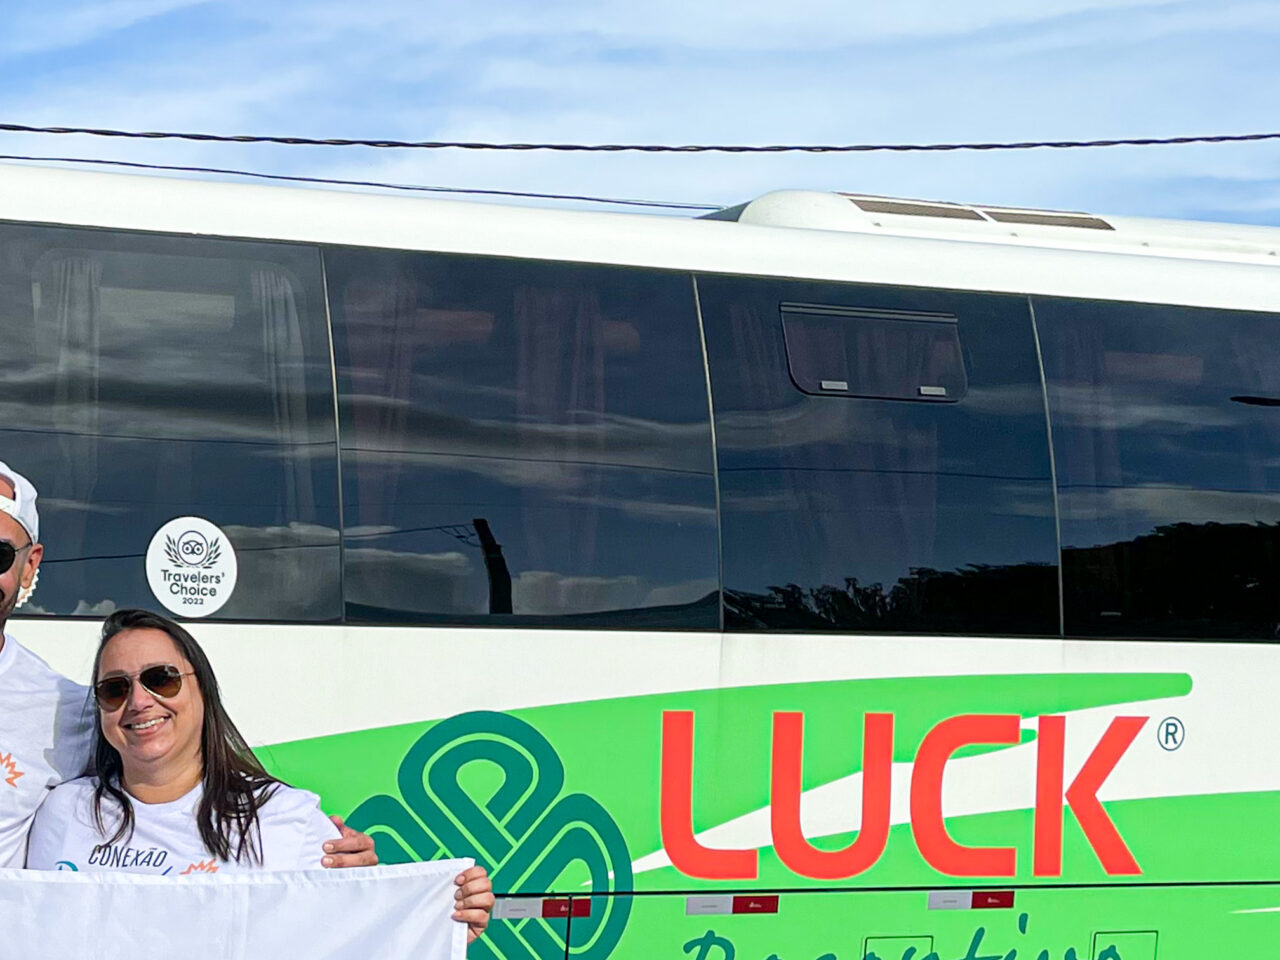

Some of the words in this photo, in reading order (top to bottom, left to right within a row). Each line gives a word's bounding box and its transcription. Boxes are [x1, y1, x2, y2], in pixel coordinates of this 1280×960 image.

[160, 569, 225, 584] Travelers'
[169, 582, 217, 597] Choice
[660, 710, 1150, 880] LUCK
[88, 844, 168, 868] CONEXÃO
